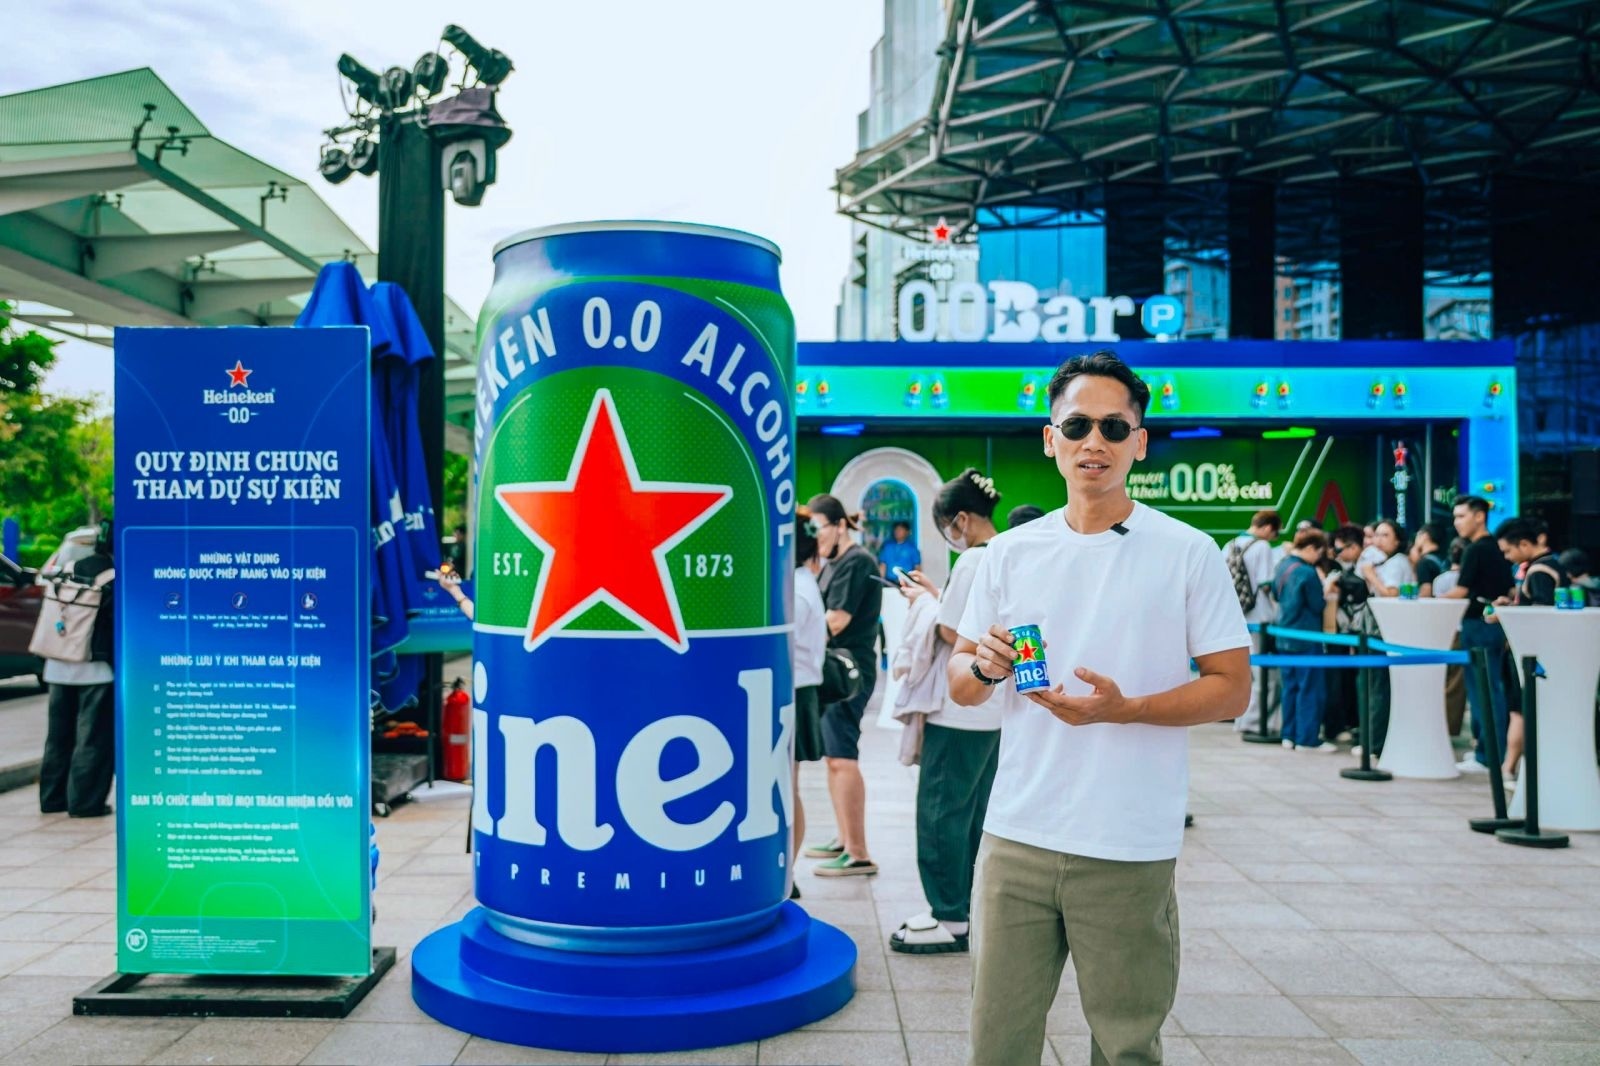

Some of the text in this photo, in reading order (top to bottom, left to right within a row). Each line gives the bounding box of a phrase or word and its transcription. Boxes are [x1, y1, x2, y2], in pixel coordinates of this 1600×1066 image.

[203, 389, 275, 404] Heineken
[583, 296, 662, 353] 0.0
[681, 322, 795, 547] ALCOHOL
[135, 451, 338, 477] QUY ĐỊNH CHUNG
[133, 473, 341, 505] THAM DỰ SỰ KIỆN
[240, 568, 268, 579] MANG
[493, 552, 734, 578] EST. 1873
[224, 655, 239, 666] KHI
[241, 655, 266, 666] THAM
[268, 655, 285, 666] GIA
[511, 863, 742, 890] PREMIUM
